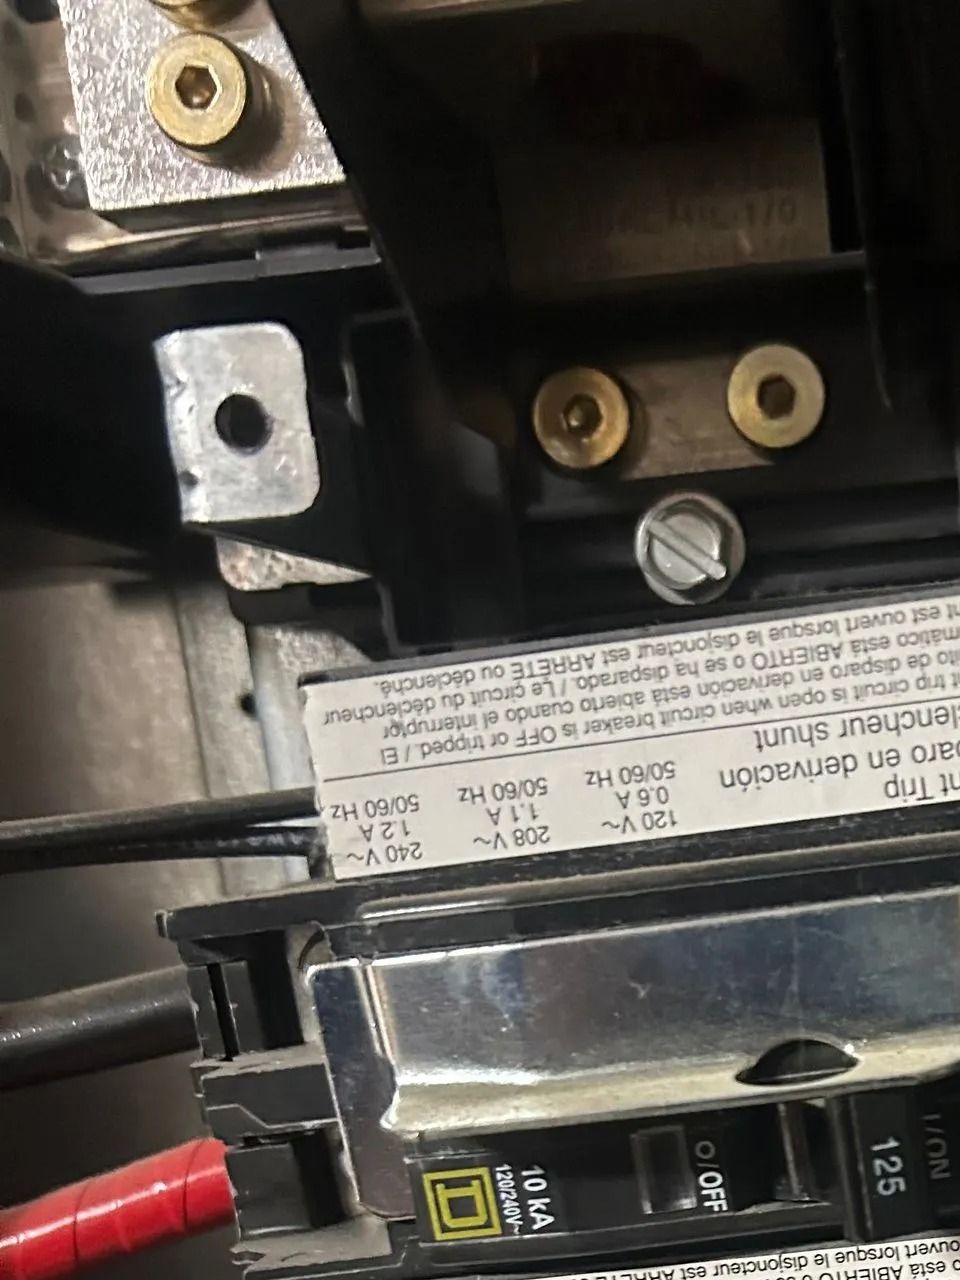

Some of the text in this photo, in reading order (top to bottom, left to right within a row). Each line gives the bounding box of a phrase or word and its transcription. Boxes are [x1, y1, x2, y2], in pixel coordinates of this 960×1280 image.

[752, 721, 829, 752] shunt
[867, 748, 901, 769] en
[584, 760, 675, 788] 50/60 Hz
[719, 753, 858, 792] derivación
[457, 776, 547, 804] 50/60 Hz
[615, 785, 669, 809] 0.6 A
[881, 769, 934, 805] Trip
[330, 793, 419, 821] 50/60 Hz
[486, 802, 538, 826] 1.1 A
[358, 819, 410, 842] 1.2 A
[641, 809, 677, 831] 120
[511, 824, 550, 847] 208
[384, 841, 422, 863] 240
[696, 1141, 727, 1212] O/OFF
[869, 1136, 906, 1195] 125
[521, 1167, 555, 1231] 10 kA
[813, 1252, 830, 1269] le
[833, 1245, 900, 1263] lorsque
[903, 1239, 960, 1259] ouvert
[711, 1253, 808, 1277] disjoncteur
[907, 1260, 946, 1279] está
